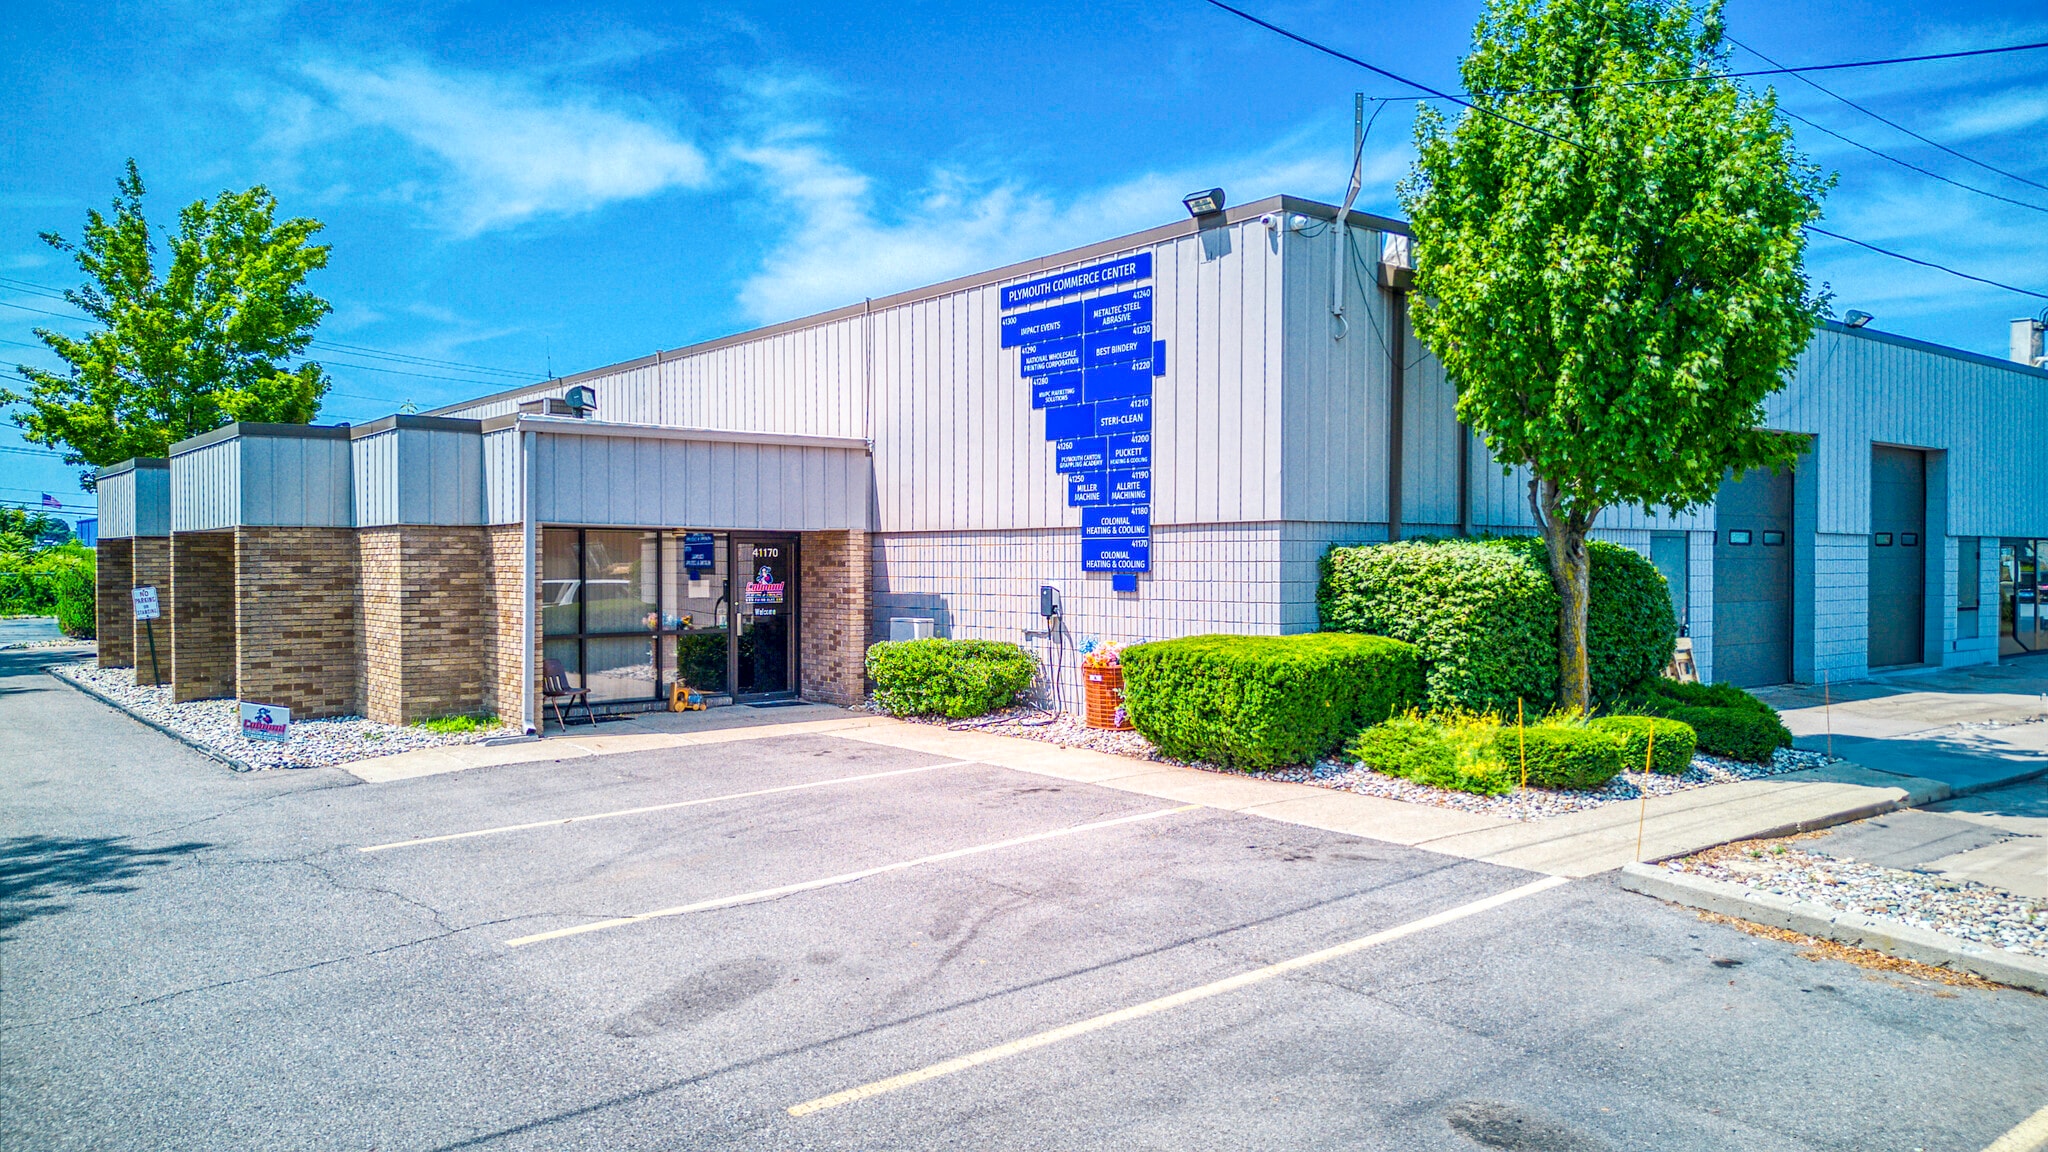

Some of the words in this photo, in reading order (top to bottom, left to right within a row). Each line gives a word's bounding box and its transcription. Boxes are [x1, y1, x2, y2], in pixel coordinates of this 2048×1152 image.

[1008, 284, 1050, 302] PLYMOUTH
[1052, 271, 1100, 291] COMMERCE
[1102, 263, 1136, 281] CENTER
[1132, 289, 1150, 299] 41240
[1093, 306, 1122, 318] METALTEC
[1123, 302, 1141, 314] STEEL
[1002, 317, 1017, 326] 41300
[1102, 312, 1131, 326] ABRASIVE
[1020, 325, 1040, 336] IMPACT
[1040, 321, 1061, 332] EVENTS
[1132, 325, 1150, 335] 41230
[1022, 346, 1036, 354] 41290
[1096, 346, 1111, 356] BEST
[1112, 342, 1138, 354] BINDERY
[1026, 355, 1048, 364] NATIONAL
[1048, 350, 1077, 360] WHOLESALE
[1024, 362, 1045, 372] PRINTING
[1046, 357, 1079, 368] CORPORATION
[1132, 361, 1150, 371] 41220
[1130, 399, 1149, 409] 41210
[1100, 413, 1144, 426] STERI-CLEAN
[1131, 434, 1150, 443] 41200
[1057, 442, 1073, 450] 41260
[1115, 448, 1142, 457] PUCKETT
[1069, 475, 1084, 483] 41250
[1131, 471, 1149, 479] 41190
[1077, 484, 1097, 492] MILLER
[1116, 482, 1140, 490] ALLRITE
[1074, 492, 1100, 501] MACHINE
[1111, 491, 1146, 500] MACHINING
[1131, 507, 1148, 515] 41180
[1101, 517, 1130, 525] COLONIAL
[1086, 526, 1111, 535] HEATING
[1112, 526, 1117, 534] &
[1118, 526, 1145, 535] COOLING
[1131, 540, 1148, 548] 41170
[752, 548, 779, 557] 41170
[1101, 551, 1130, 559] COLONIAL
[1086, 560, 1111, 569] HEATING
[1112, 560, 1117, 568] &
[1118, 560, 1145, 569] COOLING
[755, 608, 776, 616] Welcome
